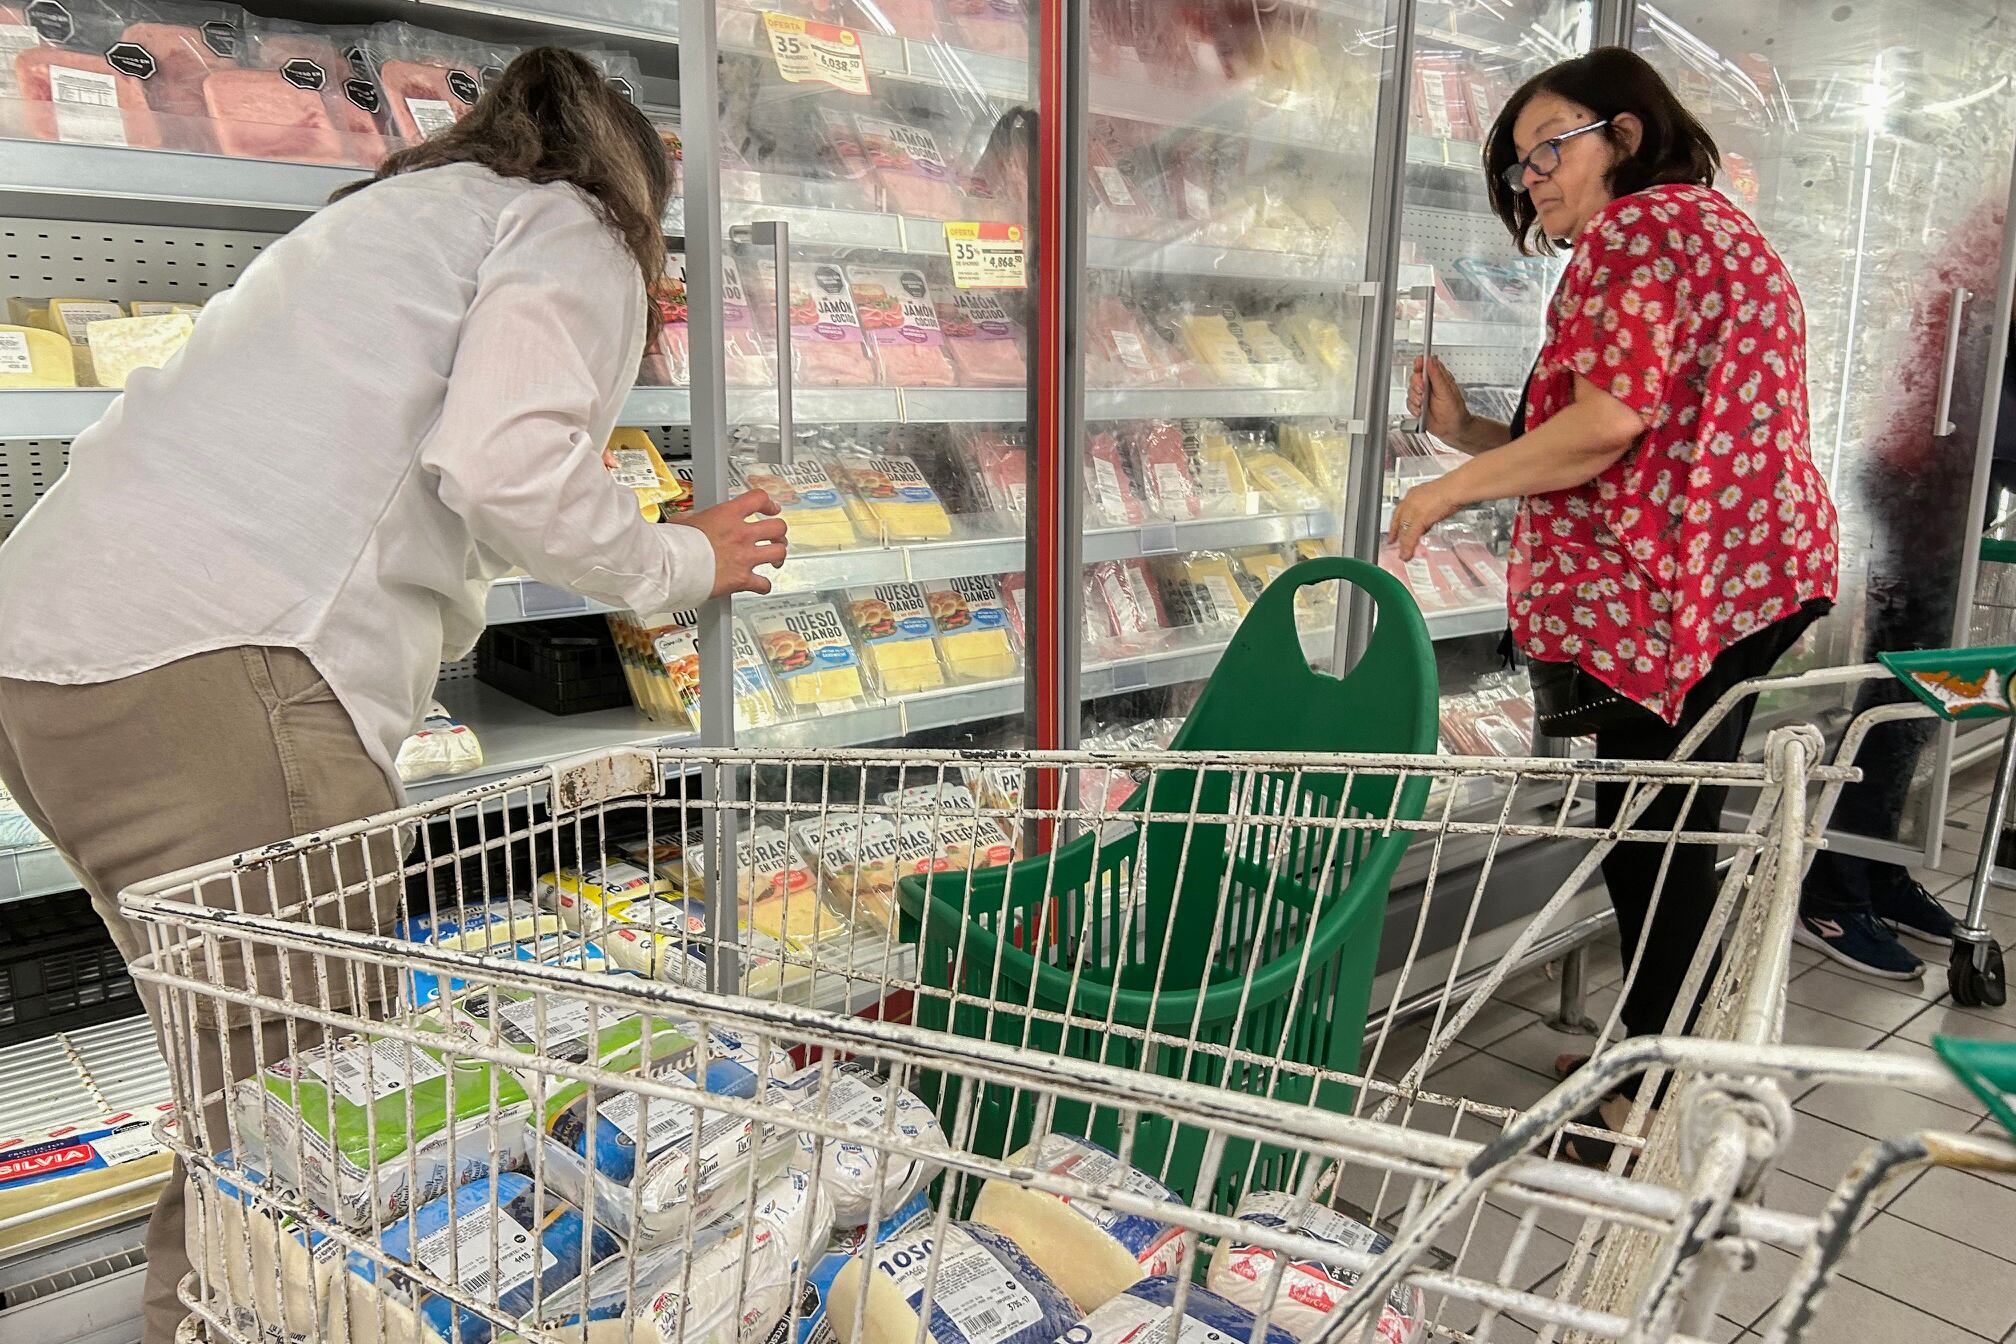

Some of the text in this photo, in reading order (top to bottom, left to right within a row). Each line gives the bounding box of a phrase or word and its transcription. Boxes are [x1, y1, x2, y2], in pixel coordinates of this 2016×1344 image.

[768, 18, 801, 30] OFERTA
[889, 128, 936, 152] JAMÓN
[949, 228, 976, 237] OFERTA
[818, 299, 854, 315] JAMÓN
[954, 293, 999, 309] JAMÓN
[904, 303, 936, 318] JAMÓN
[969, 310, 1005, 320] COCIDO
[768, 460, 821, 476] QUESO
[868, 459, 916, 473] QUESO
[789, 473, 827, 486] DANBO
[888, 473, 922, 482] DANBO
[874, 583, 920, 603] QUESO
[963, 590, 996, 603] DANBO
[888, 599, 924, 612] DANBO
[785, 610, 838, 633] QUESO
[803, 626, 842, 642] DANBO
[901, 850, 914, 861] EN
[759, 861, 771, 873] EN
[0, 1149, 85, 1175] SILVIA
